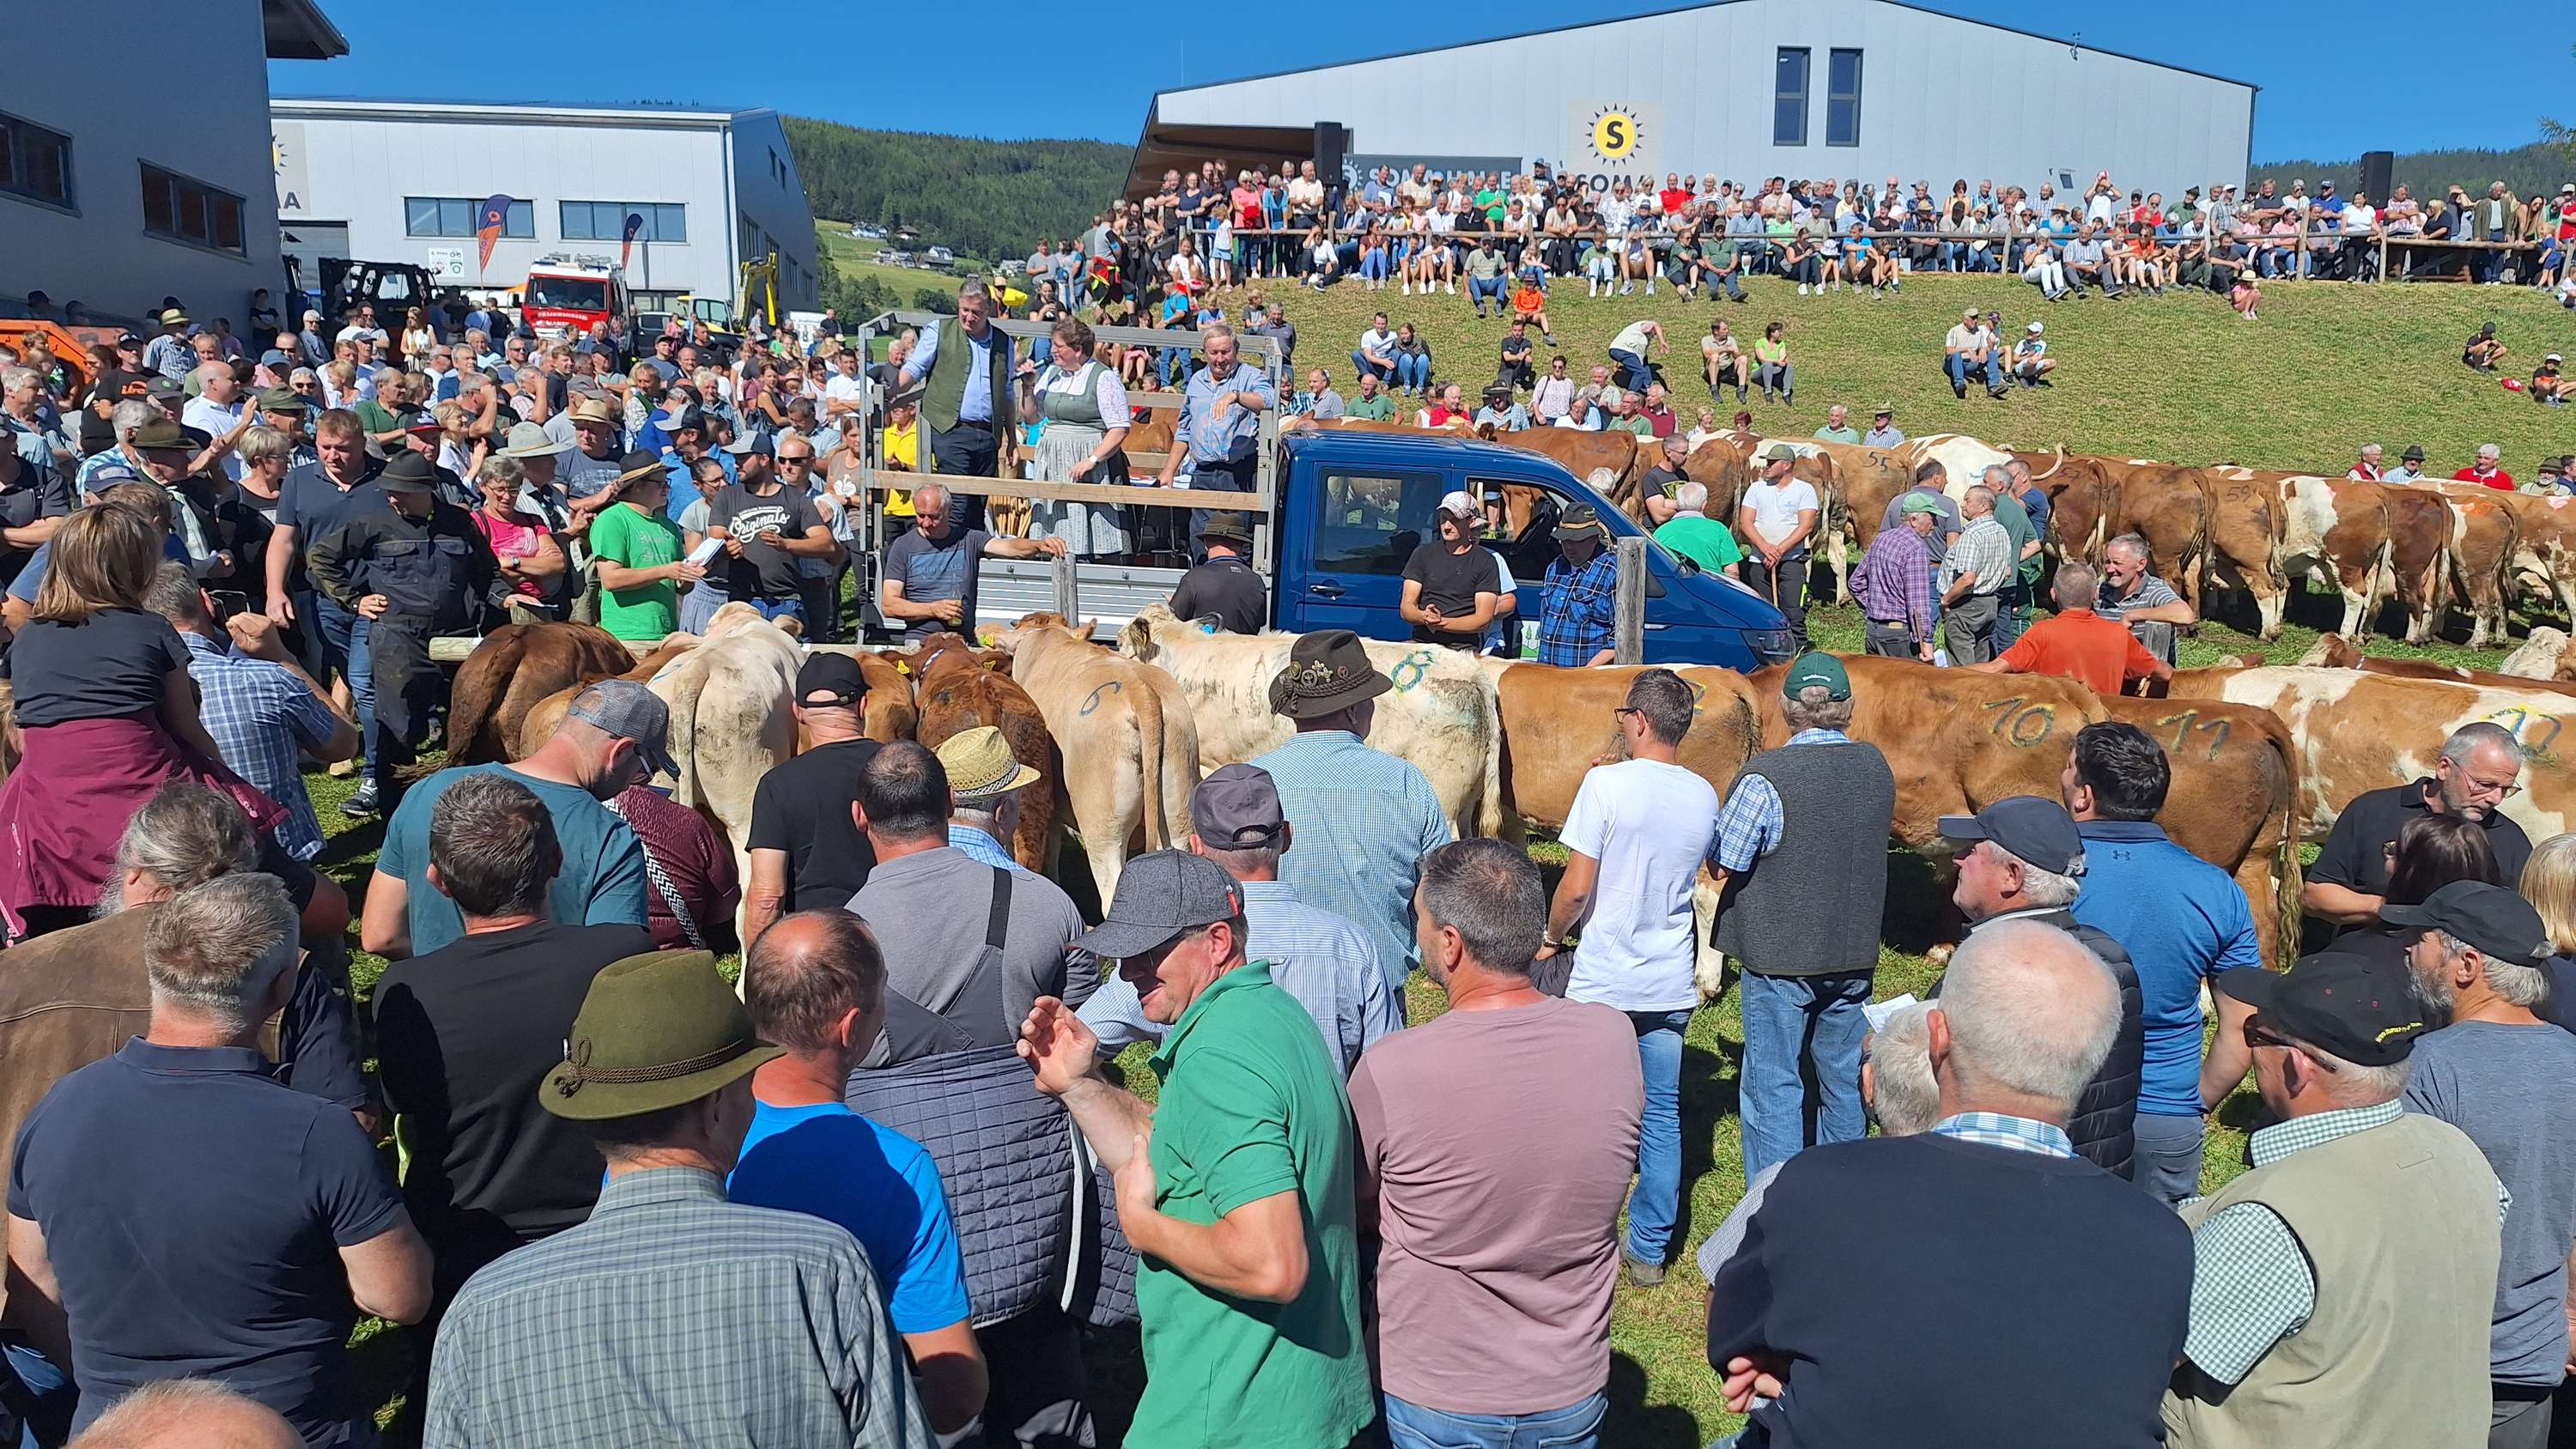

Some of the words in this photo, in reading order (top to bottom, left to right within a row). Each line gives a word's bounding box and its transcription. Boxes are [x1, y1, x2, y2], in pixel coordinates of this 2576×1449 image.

[1606, 121, 1625, 149] S
[1577, 174, 1645, 194] SOM
[1862, 451, 1892, 473] 55
[2225, 485, 2251, 503] 59
[729, 506, 791, 543] Originals
[1983, 695, 2057, 748] 10
[2157, 709, 2232, 761] 11
